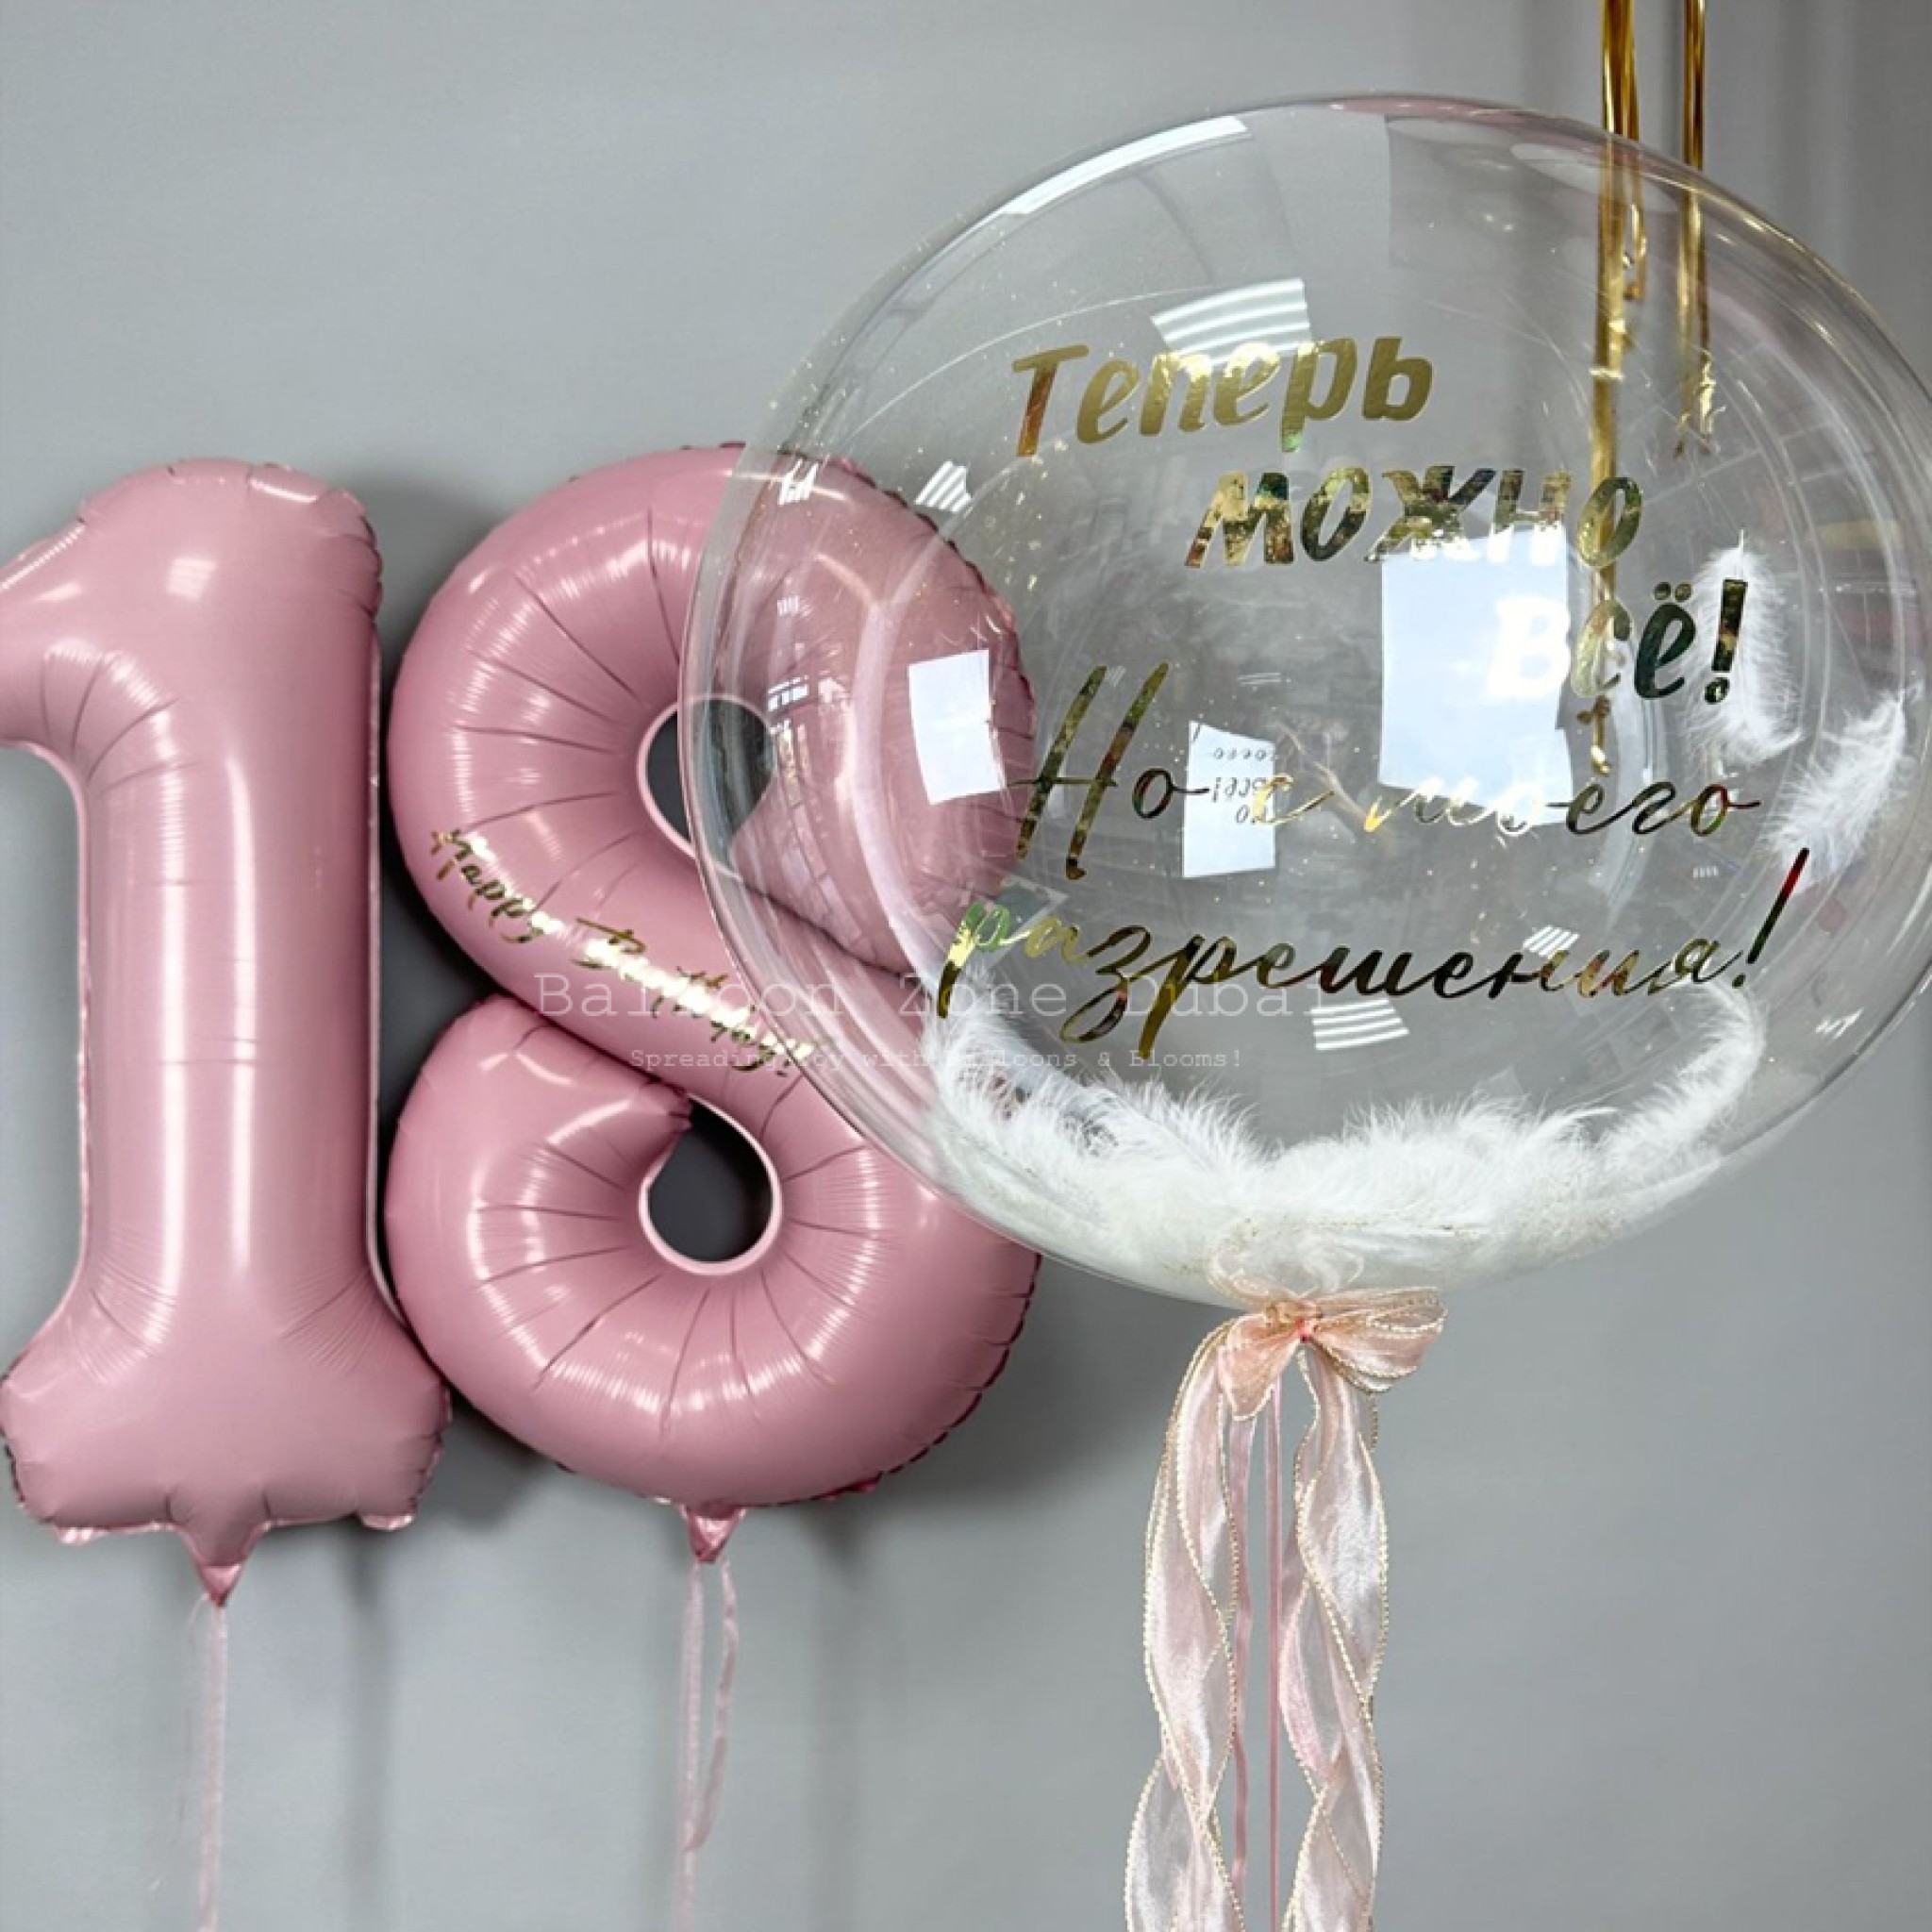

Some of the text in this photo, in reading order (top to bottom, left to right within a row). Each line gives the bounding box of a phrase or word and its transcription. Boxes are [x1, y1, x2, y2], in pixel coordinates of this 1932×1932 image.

[1012, 336, 1435, 458] Теперь
[1184, 464, 1644, 569] можно
[1486, 578, 1749, 704] всё!
[1007, 662, 1209, 881] Но
[429, 828, 565, 944] Happy
[937, 847, 1810, 1061] разрешения!
